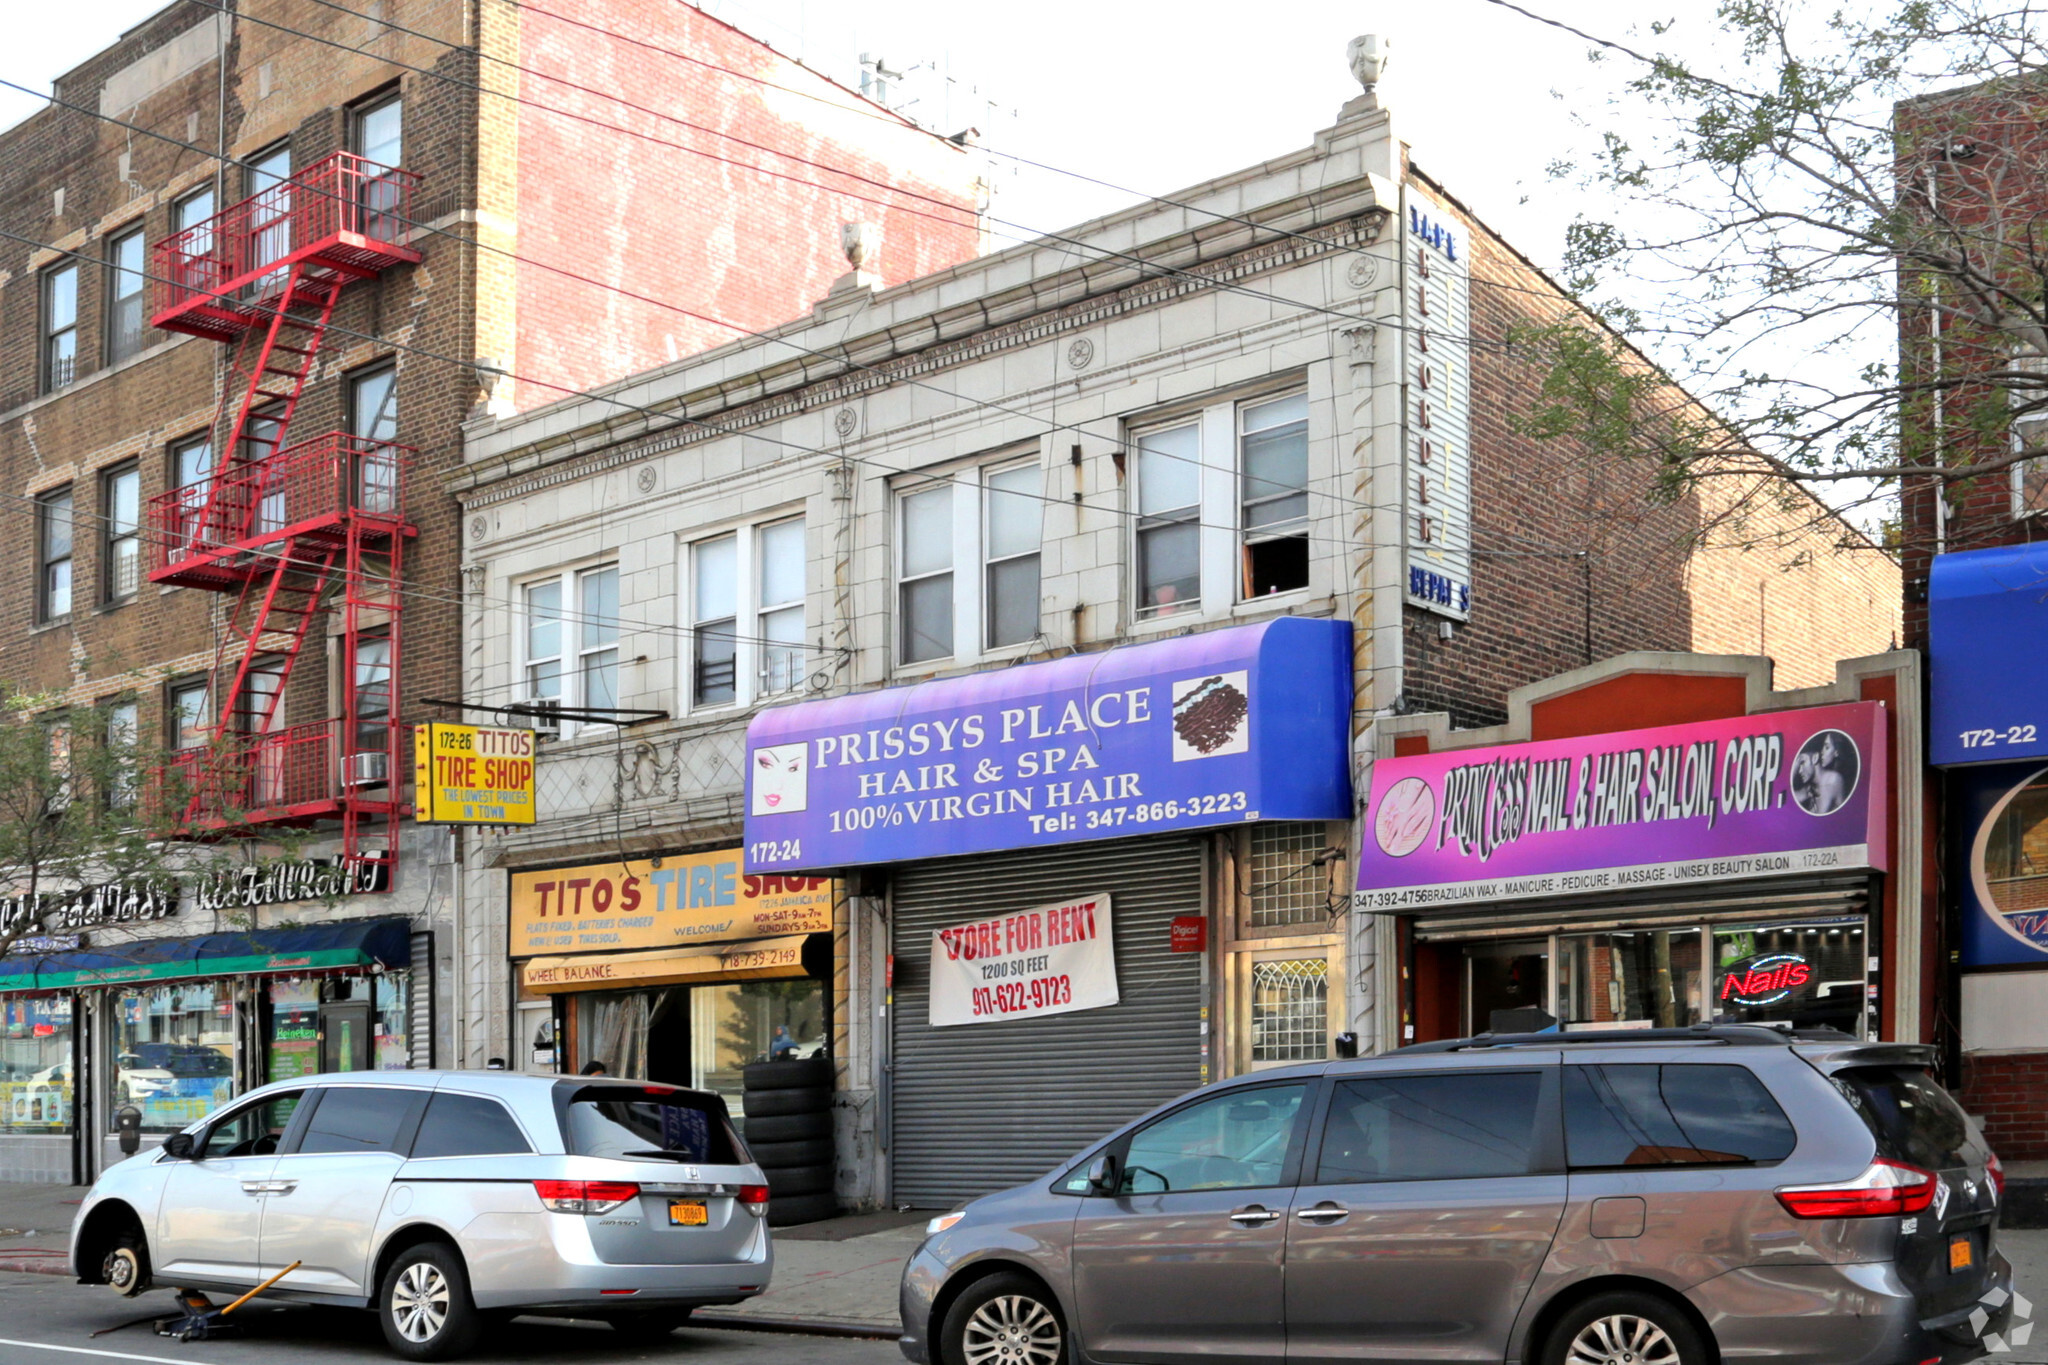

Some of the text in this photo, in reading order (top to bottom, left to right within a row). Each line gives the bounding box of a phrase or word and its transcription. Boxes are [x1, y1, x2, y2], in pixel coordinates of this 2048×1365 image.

[814, 687, 1153, 769] PRISSYS PLACE
[1959, 724, 2036, 748] 172-22
[439, 732, 472, 750] 172-26
[436, 755, 532, 790] TIRE SHOP
[857, 745, 1100, 798] HAIR & SPA
[443, 788, 529, 805] THE LOWEST PRICES
[1045, 772, 1143, 807] HAIR
[1525, 757, 1572, 834] NAIL
[1573, 754, 1592, 831] &
[1592, 748, 1646, 829] HAIR
[463, 804, 506, 819] IN TOWN
[1028, 791, 1248, 835] Tel: 347-866-3223
[750, 838, 801, 864] 172-24
[1802, 853, 1839, 868] 172-22A
[534, 872, 643, 917] TITO'S
[650, 861, 737, 911] TIRE
[1477, 884, 1498, 897] WAX
[1504, 879, 1554, 895] MANICURE
[1561, 873, 1610, 890] PEDICURE
[1617, 867, 1666, 884] MASSAGE
[1674, 863, 1710, 881] UNISEX
[1712, 860, 1752, 876] BEAUTY
[1753, 856, 1790, 872] SALON
[780, 896, 813, 907] JAMAICA
[1355, 890, 1428, 908] 347-392-4756
[940, 902, 1097, 961] STORE FOR RENT
[1173, 924, 1199, 937] Digicel
[528, 967, 559, 983] WHEEL
[981, 955, 1050, 980] 1200 SQ FEET
[1720, 961, 1812, 1000] Nails
[276, 1026, 316, 1040] Heineken
